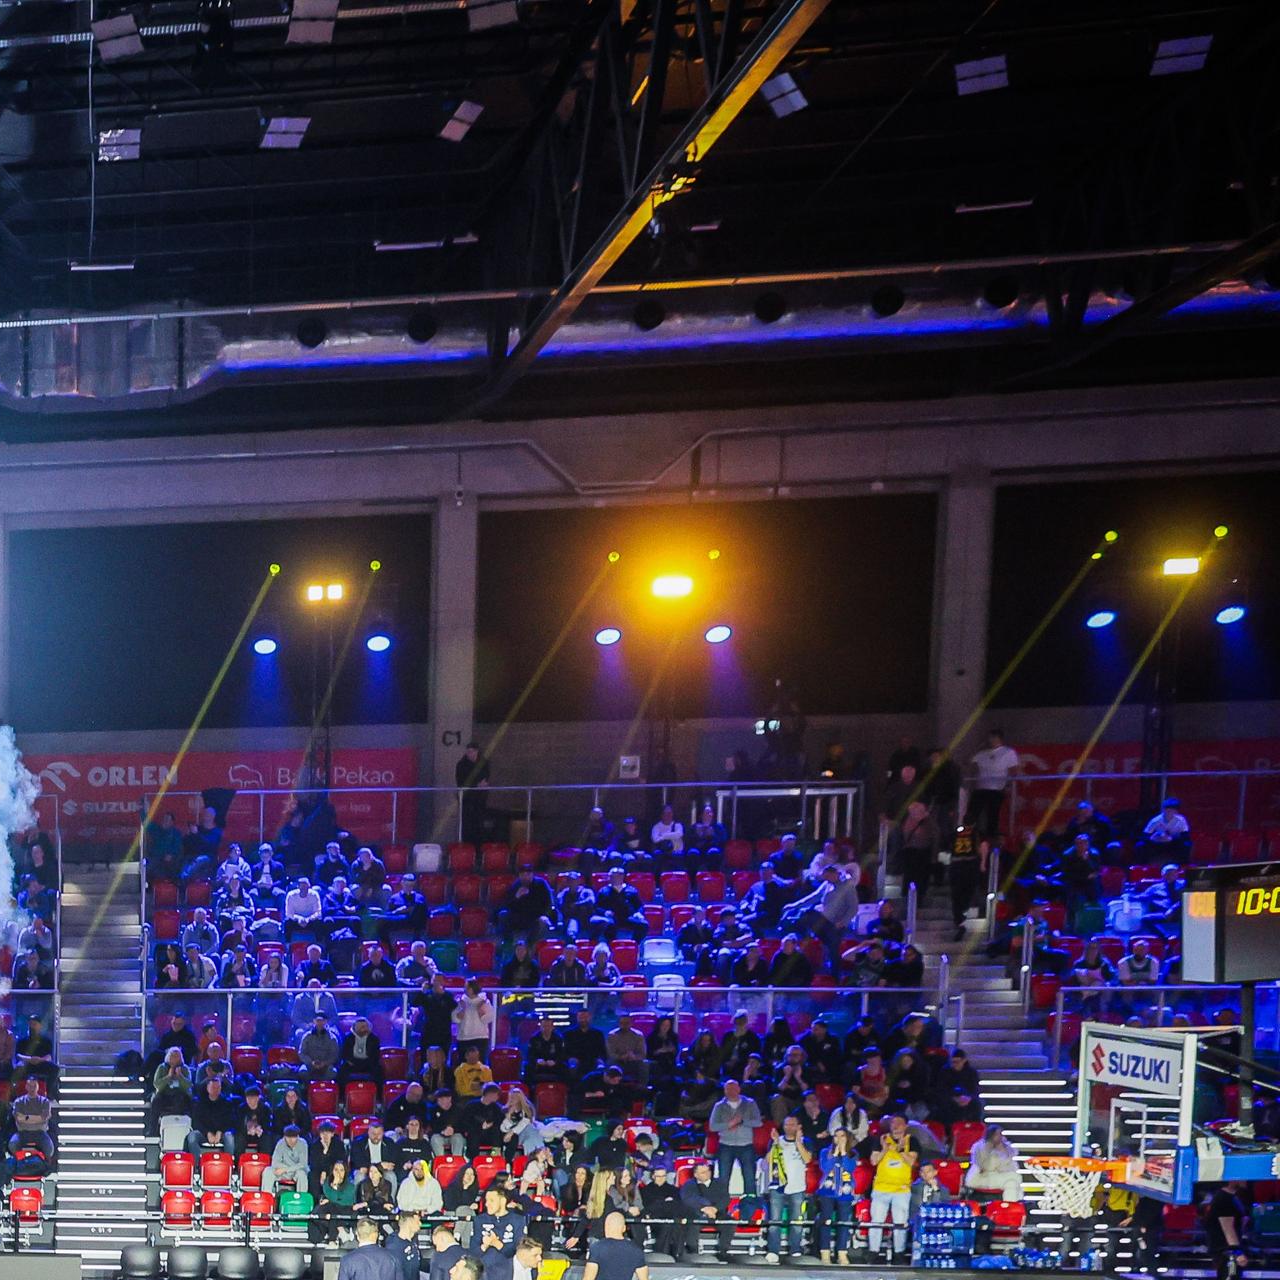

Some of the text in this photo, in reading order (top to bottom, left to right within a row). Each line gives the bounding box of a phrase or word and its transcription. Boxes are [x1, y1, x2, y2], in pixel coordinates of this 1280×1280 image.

[87, 765, 179, 786] ORLEN
[334, 767, 395, 785] Pekao
[1108, 1051, 1170, 1084] SUZUKI
